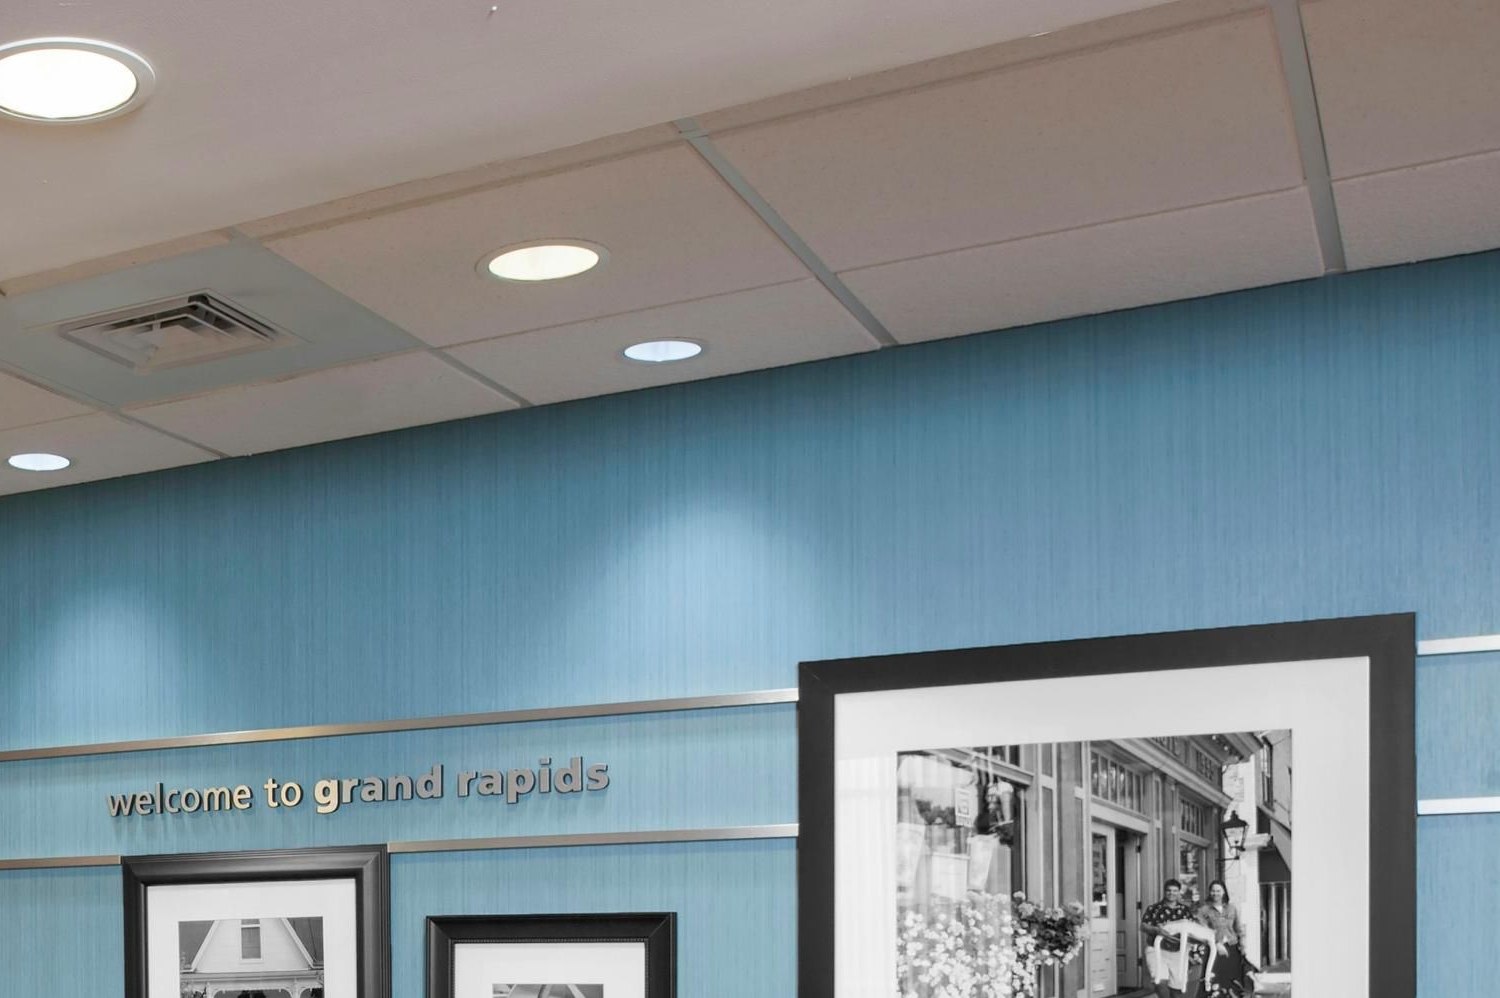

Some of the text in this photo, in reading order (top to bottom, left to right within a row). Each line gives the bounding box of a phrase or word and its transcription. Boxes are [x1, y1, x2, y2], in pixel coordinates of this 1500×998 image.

[108, 756, 609, 817] welcome to grand rapids
